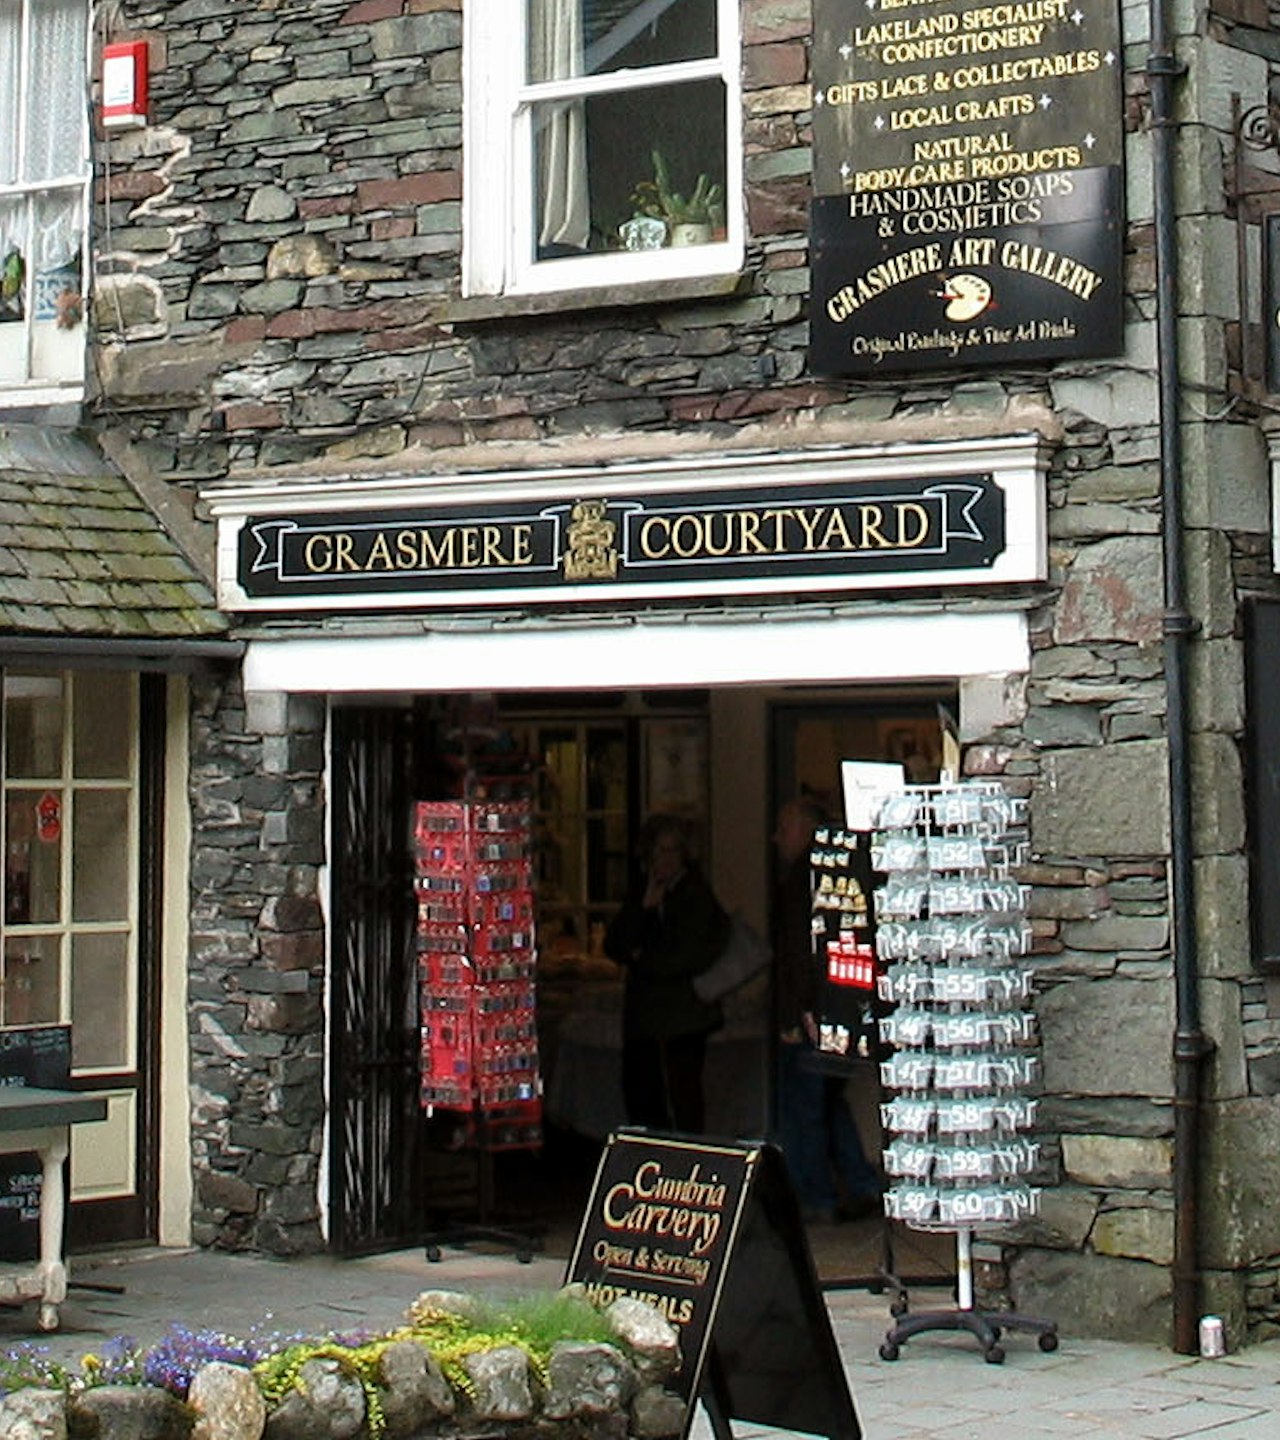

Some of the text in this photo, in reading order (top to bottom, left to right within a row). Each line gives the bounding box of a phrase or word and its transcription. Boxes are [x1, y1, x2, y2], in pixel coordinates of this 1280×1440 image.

[854, 14, 958, 46] LAKELAND
[882, 24, 1045, 65] CONFECTIONERY
[827, 50, 1101, 106] GIFTS LACE & COLLECTABLES
[890, 94, 1035, 131] LOCAL CRAFTS
[914, 132, 1013, 162] NATURAL
[910, 159, 965, 188] CARE
[972, 145, 1081, 176] PRODUCTS
[849, 172, 1075, 218] HANDMADE SOAPS
[878, 199, 1042, 239] & COSMETICS
[827, 238, 1103, 324] GRASMERE ART GALLERY
[966, 329, 980, 346] &
[303, 501, 929, 574] GRASMERE COURTYARD
[943, 842, 969, 861] 52
[943, 885, 971, 904] 53
[943, 927, 971, 949] 54
[946, 973, 975, 994] 55
[946, 1018, 974, 1039] 56
[951, 1104, 980, 1124] 58
[952, 1150, 981, 1171] 59
[635, 1161, 727, 1207] Cumbria
[603, 1182, 721, 1253] Carvery
[952, 1194, 983, 1214] 60
[634, 1246, 650, 1268] &
